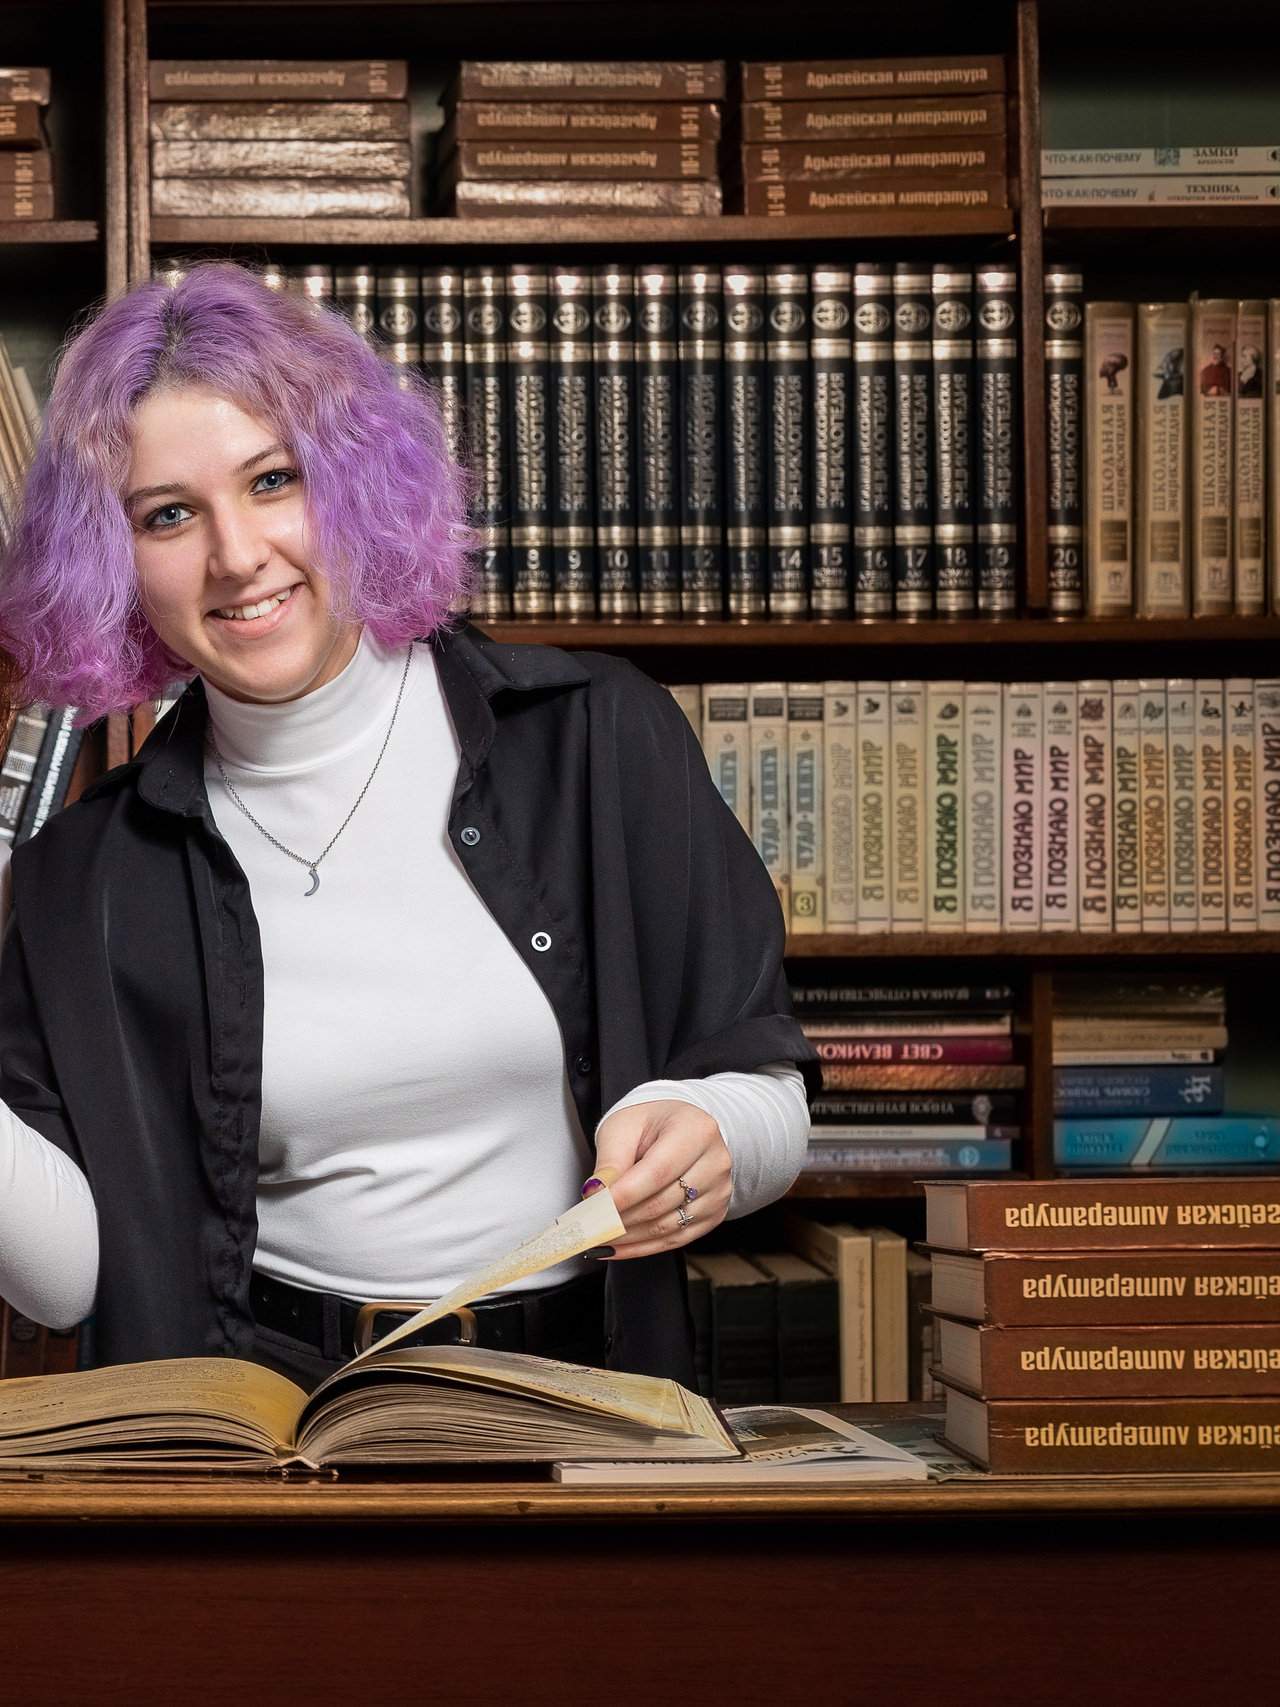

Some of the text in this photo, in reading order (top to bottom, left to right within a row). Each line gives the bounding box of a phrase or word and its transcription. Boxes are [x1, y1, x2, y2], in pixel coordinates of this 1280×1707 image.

[807, 68, 987, 89] Адыгейская литература
[806, 110, 987, 129] Адыгейская литература
[804, 151, 985, 171] Адыгейская литература
[1193, 148, 1238, 158] ЗАМКИ
[809, 190, 988, 208] Адыгейская литература
[1185, 184, 1240, 194] ТЕХНИКА
[829, 372, 845, 508] ЭНЦИКЛОПЕДИЯ
[953, 374, 969, 509] ЭНЦИКЛОПЕДИЯ
[1063, 374, 1078, 510] ЭНЦИКЛОПЕДИЯ
[1102, 404, 1114, 511] ШКОЛЬНАЯ
[1153, 405, 1166, 511] ШКОЛЬНАЯ
[1203, 401, 1216, 507] ШКОЛЬНАЯ
[485, 550, 497, 570] 7
[527, 549, 541, 570] 8
[569, 549, 581, 570] 9
[607, 550, 628, 570] 10
[778, 549, 801, 569] 14
[820, 546, 843, 566] 15
[865, 549, 888, 569] 16
[904, 549, 927, 568] 17
[945, 547, 967, 567] 18
[986, 547, 1009, 567] 19
[1053, 548, 1077, 567] 20
[862, 739, 884, 901] Я ПОЗНАЮ МИР
[933, 733, 958, 913] Я ПОЗНАЮ МИР
[1012, 748, 1034, 912] Я ПОЗНАЮ МИР
[1045, 745, 1069, 909] Я ПОЗНАЮ МИР
[1083, 734, 1106, 913] Я ПОЗНАЮ МИР
[1116, 747, 1138, 910] Я ПОЗНАЮ МИР
[1233, 744, 1253, 909] Я ПОЗНАЮ МИР
[799, 895, 811, 912] 3
[900, 1044, 943, 1060] СВЕТ
[1005, 1202, 1280, 1228] гейская литература
[1022, 1273, 1280, 1300] ейская литература
[1021, 1346, 1280, 1373] ейская литература
[1024, 1422, 1189, 1447] литература
